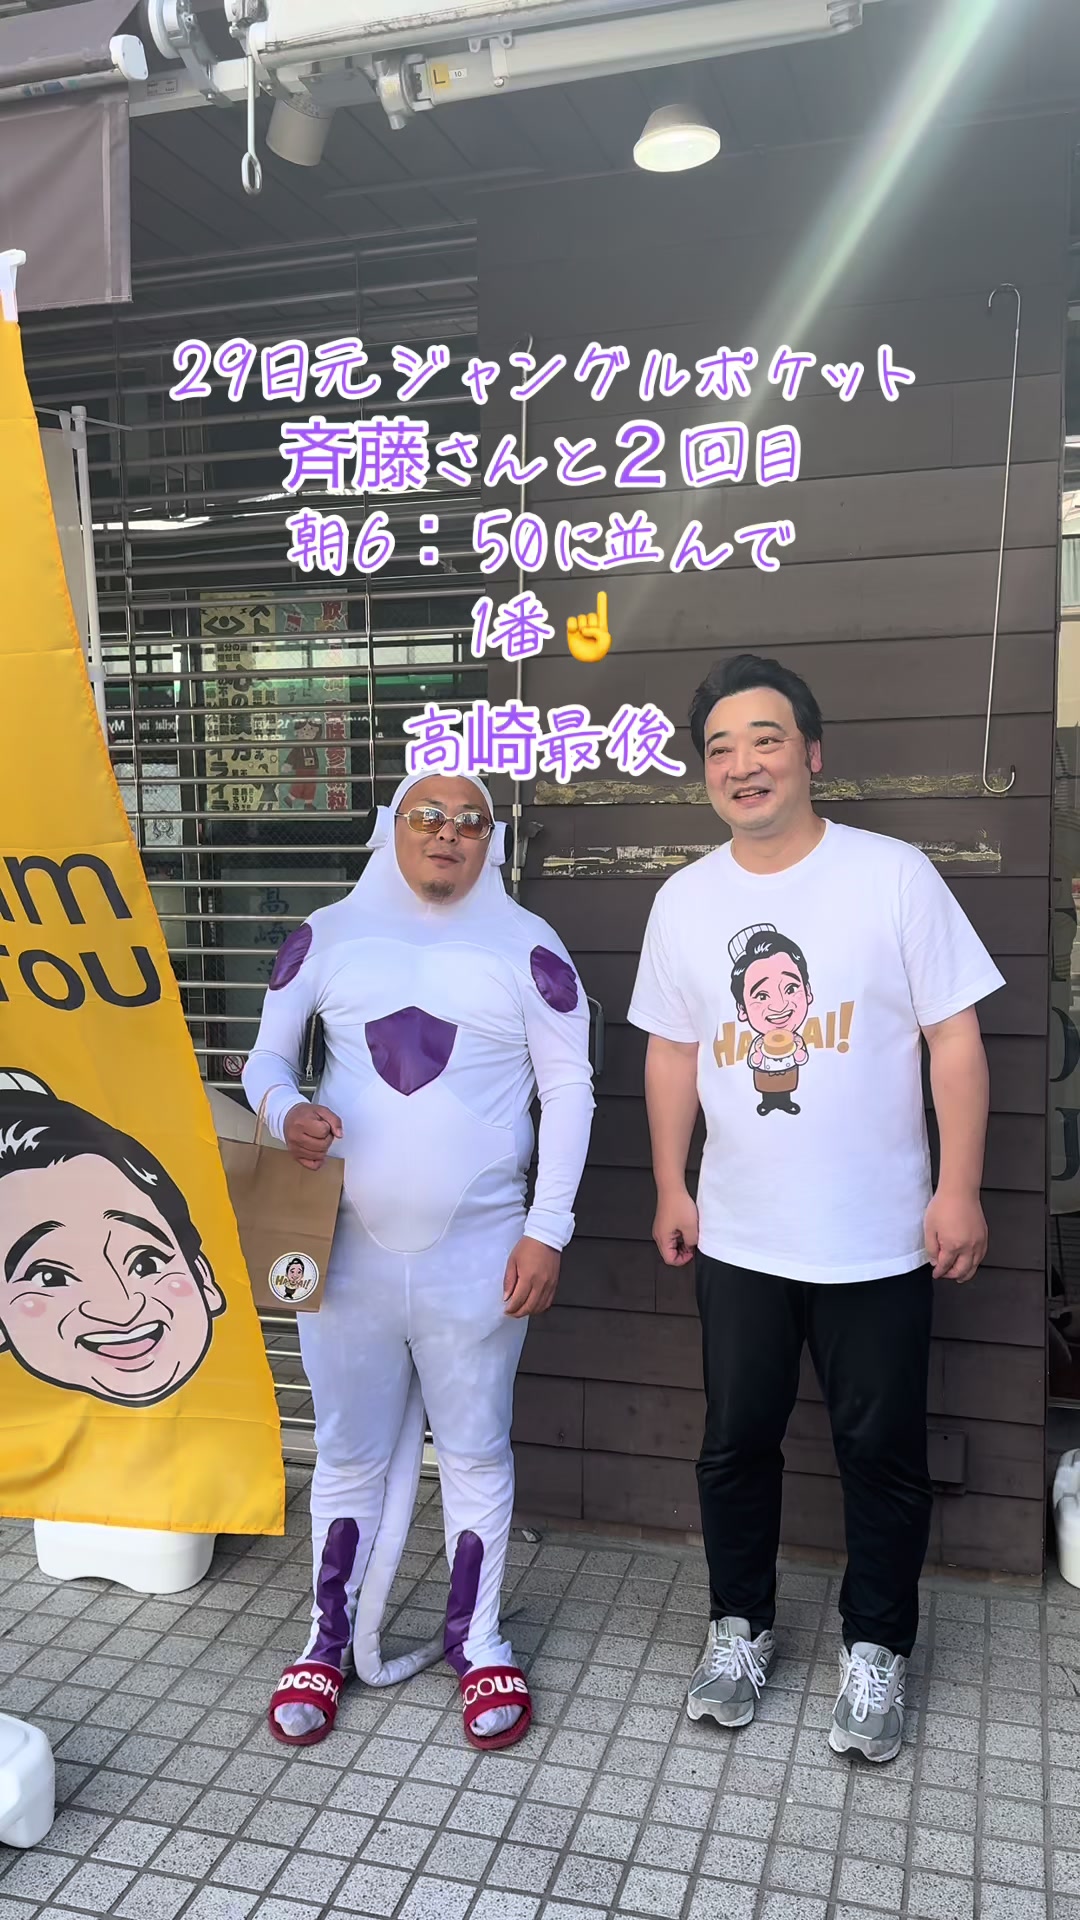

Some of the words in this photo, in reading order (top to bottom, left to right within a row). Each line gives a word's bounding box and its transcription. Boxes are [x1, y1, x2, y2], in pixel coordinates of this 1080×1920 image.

[0, 944, 161, 1011] ou
[276, 1670, 340, 1707] DCSH
[463, 1675, 529, 1713] COUS
